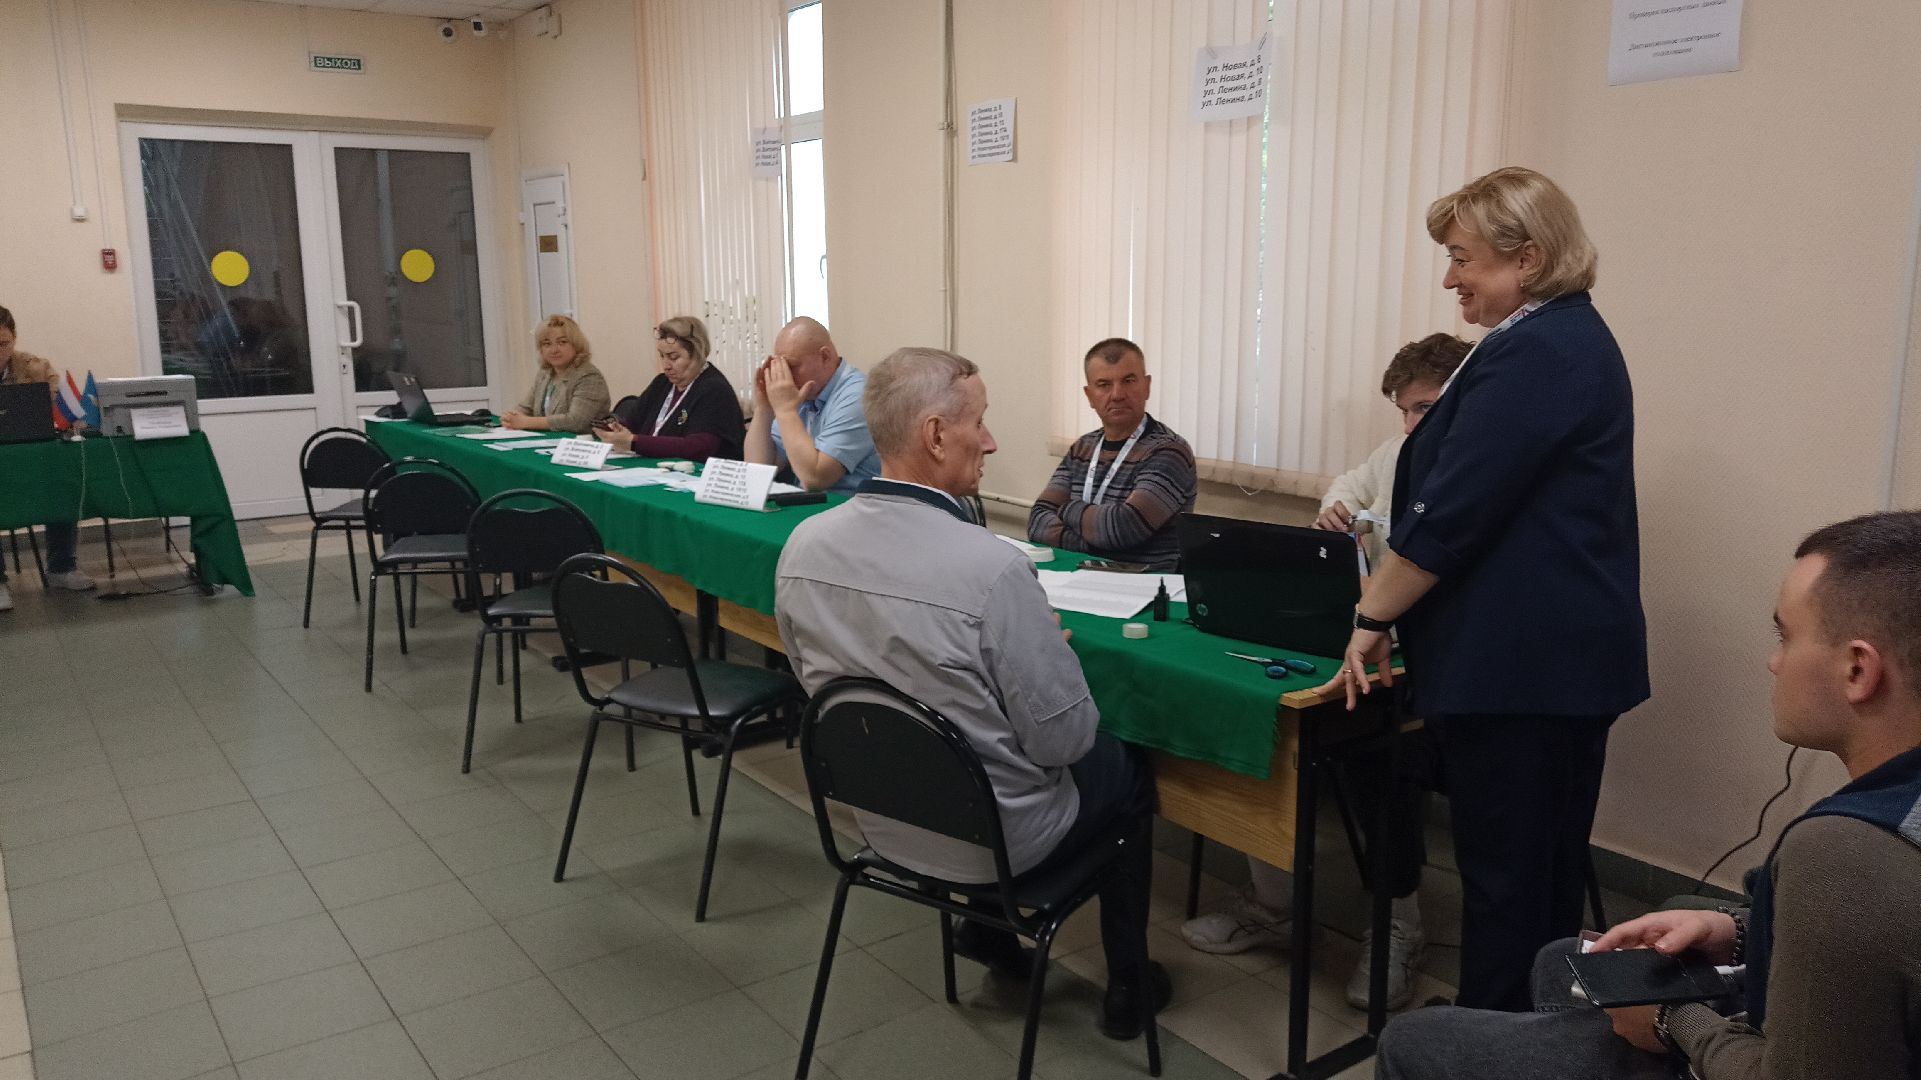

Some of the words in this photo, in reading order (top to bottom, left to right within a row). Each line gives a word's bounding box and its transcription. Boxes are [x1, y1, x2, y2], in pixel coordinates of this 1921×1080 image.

[316, 57, 359, 69] ВЫХОД
[1206, 65, 1220, 75] ул.
[1205, 77, 1218, 86] ул.
[1203, 88, 1216, 98] ул.
[1201, 99, 1214, 109] ул.
